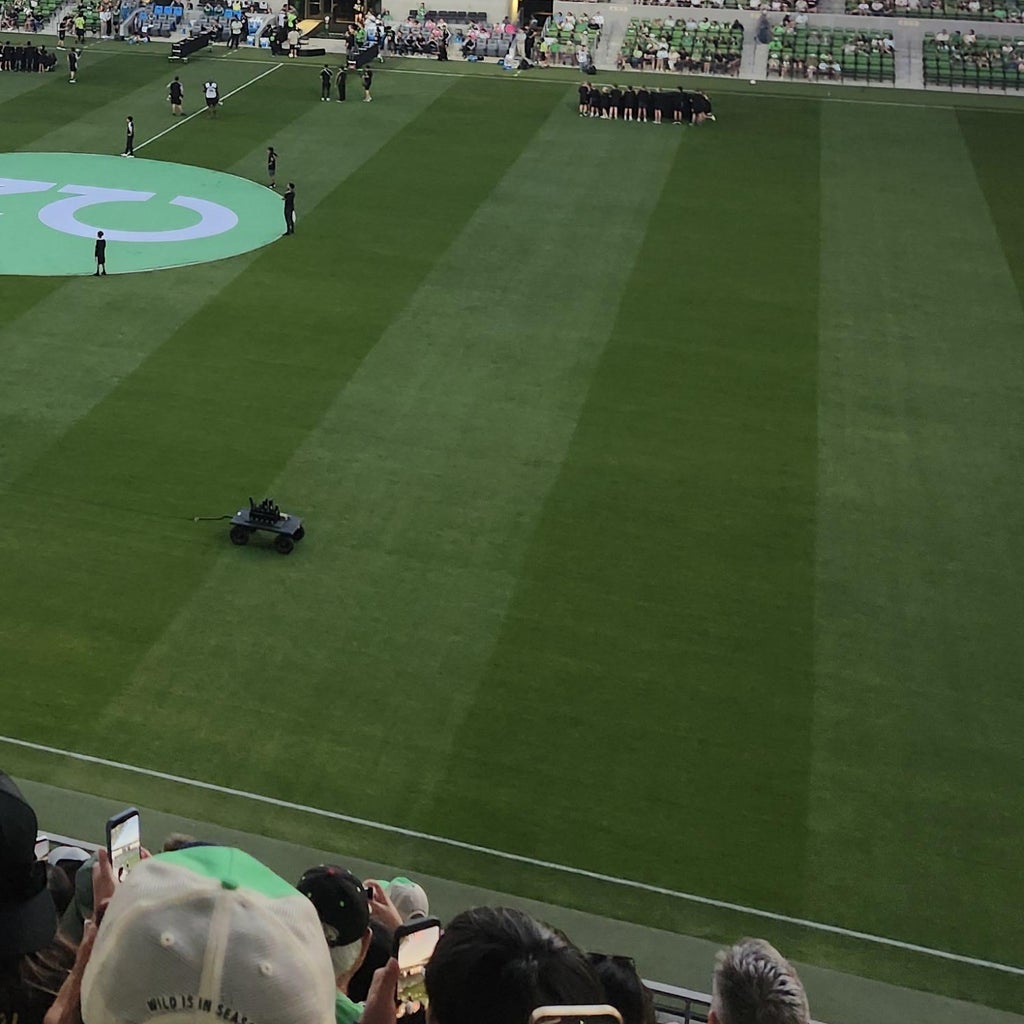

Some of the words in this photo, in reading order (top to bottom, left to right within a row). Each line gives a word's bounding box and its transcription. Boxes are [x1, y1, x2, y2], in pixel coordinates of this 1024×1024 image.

[147, 996, 176, 1011] WILD
[182, 995, 193, 1008] IS
[198, 997, 212, 1012] IN
